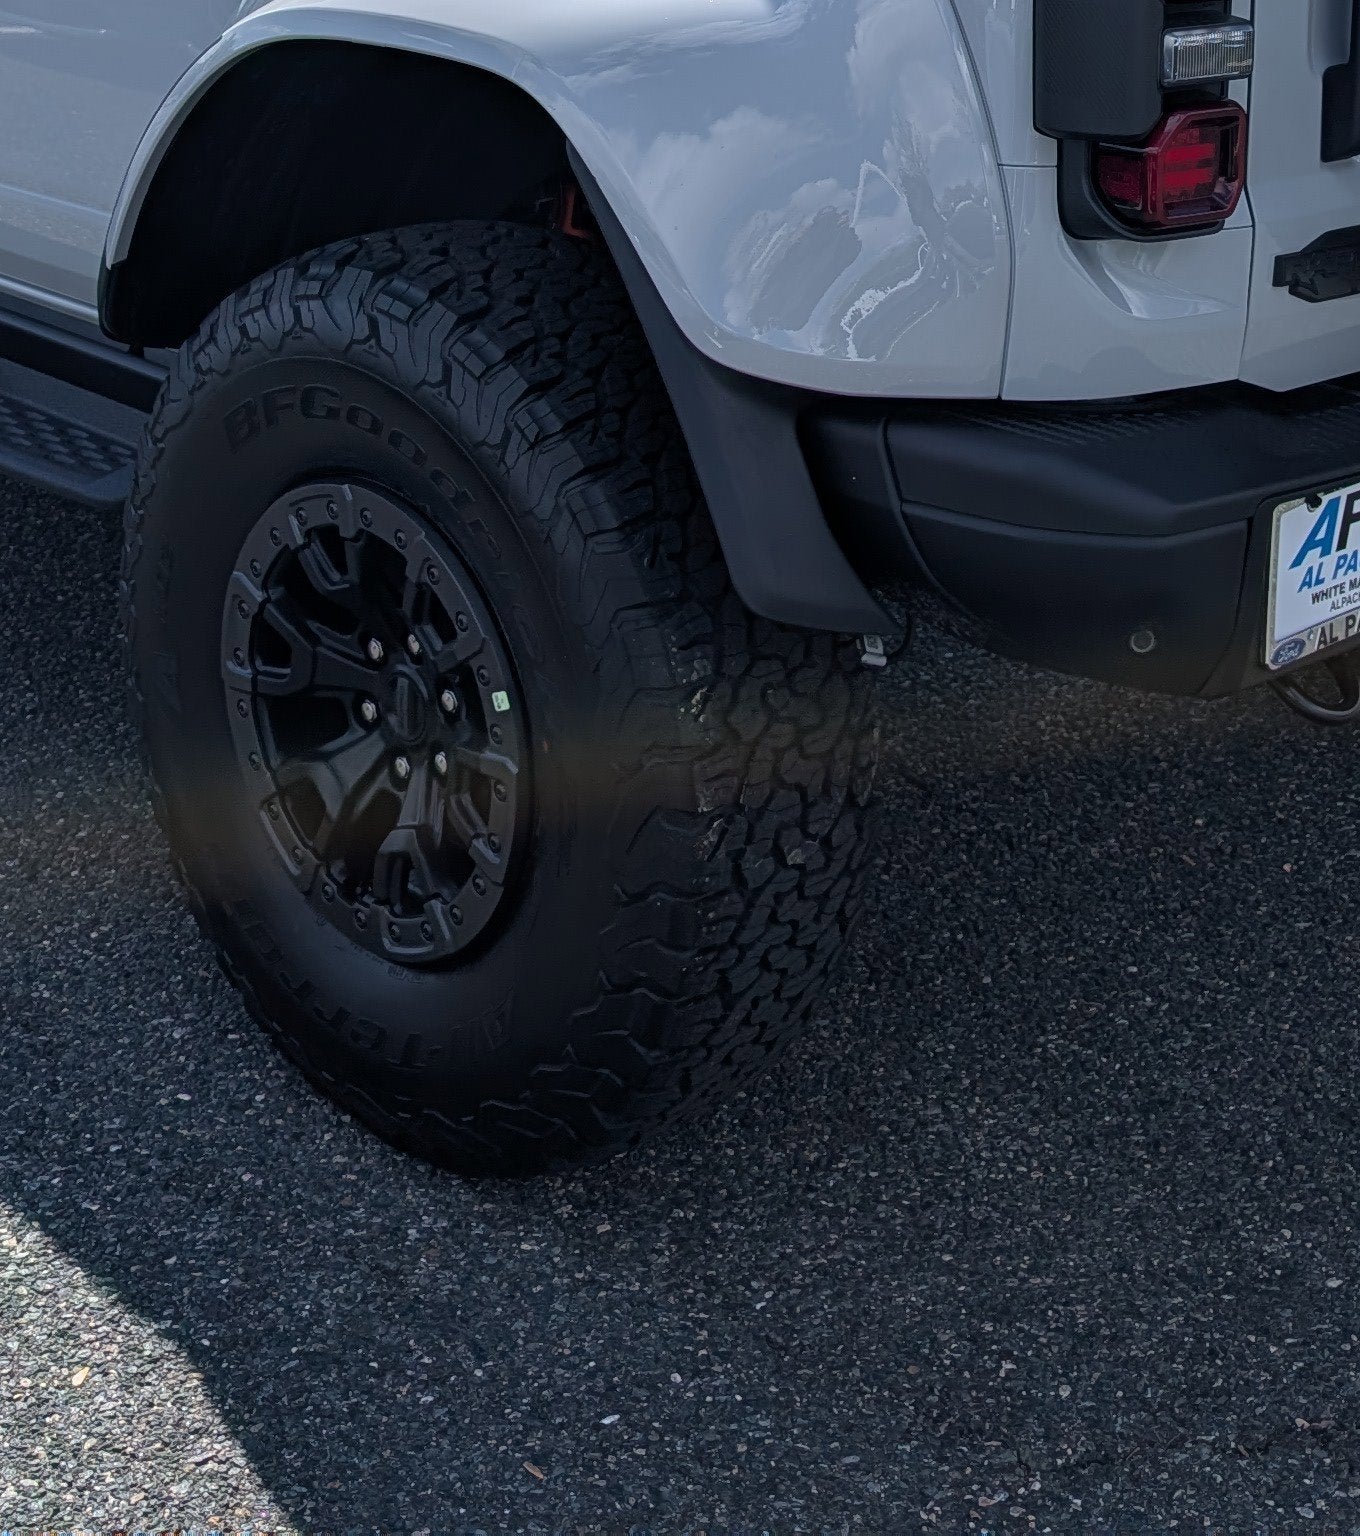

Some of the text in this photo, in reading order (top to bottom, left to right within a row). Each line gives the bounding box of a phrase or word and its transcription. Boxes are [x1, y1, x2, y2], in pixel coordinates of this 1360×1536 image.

[1297, 564, 1325, 594] AL
[1311, 581, 1346, 605] WHITE
[1315, 624, 1339, 651] AL
